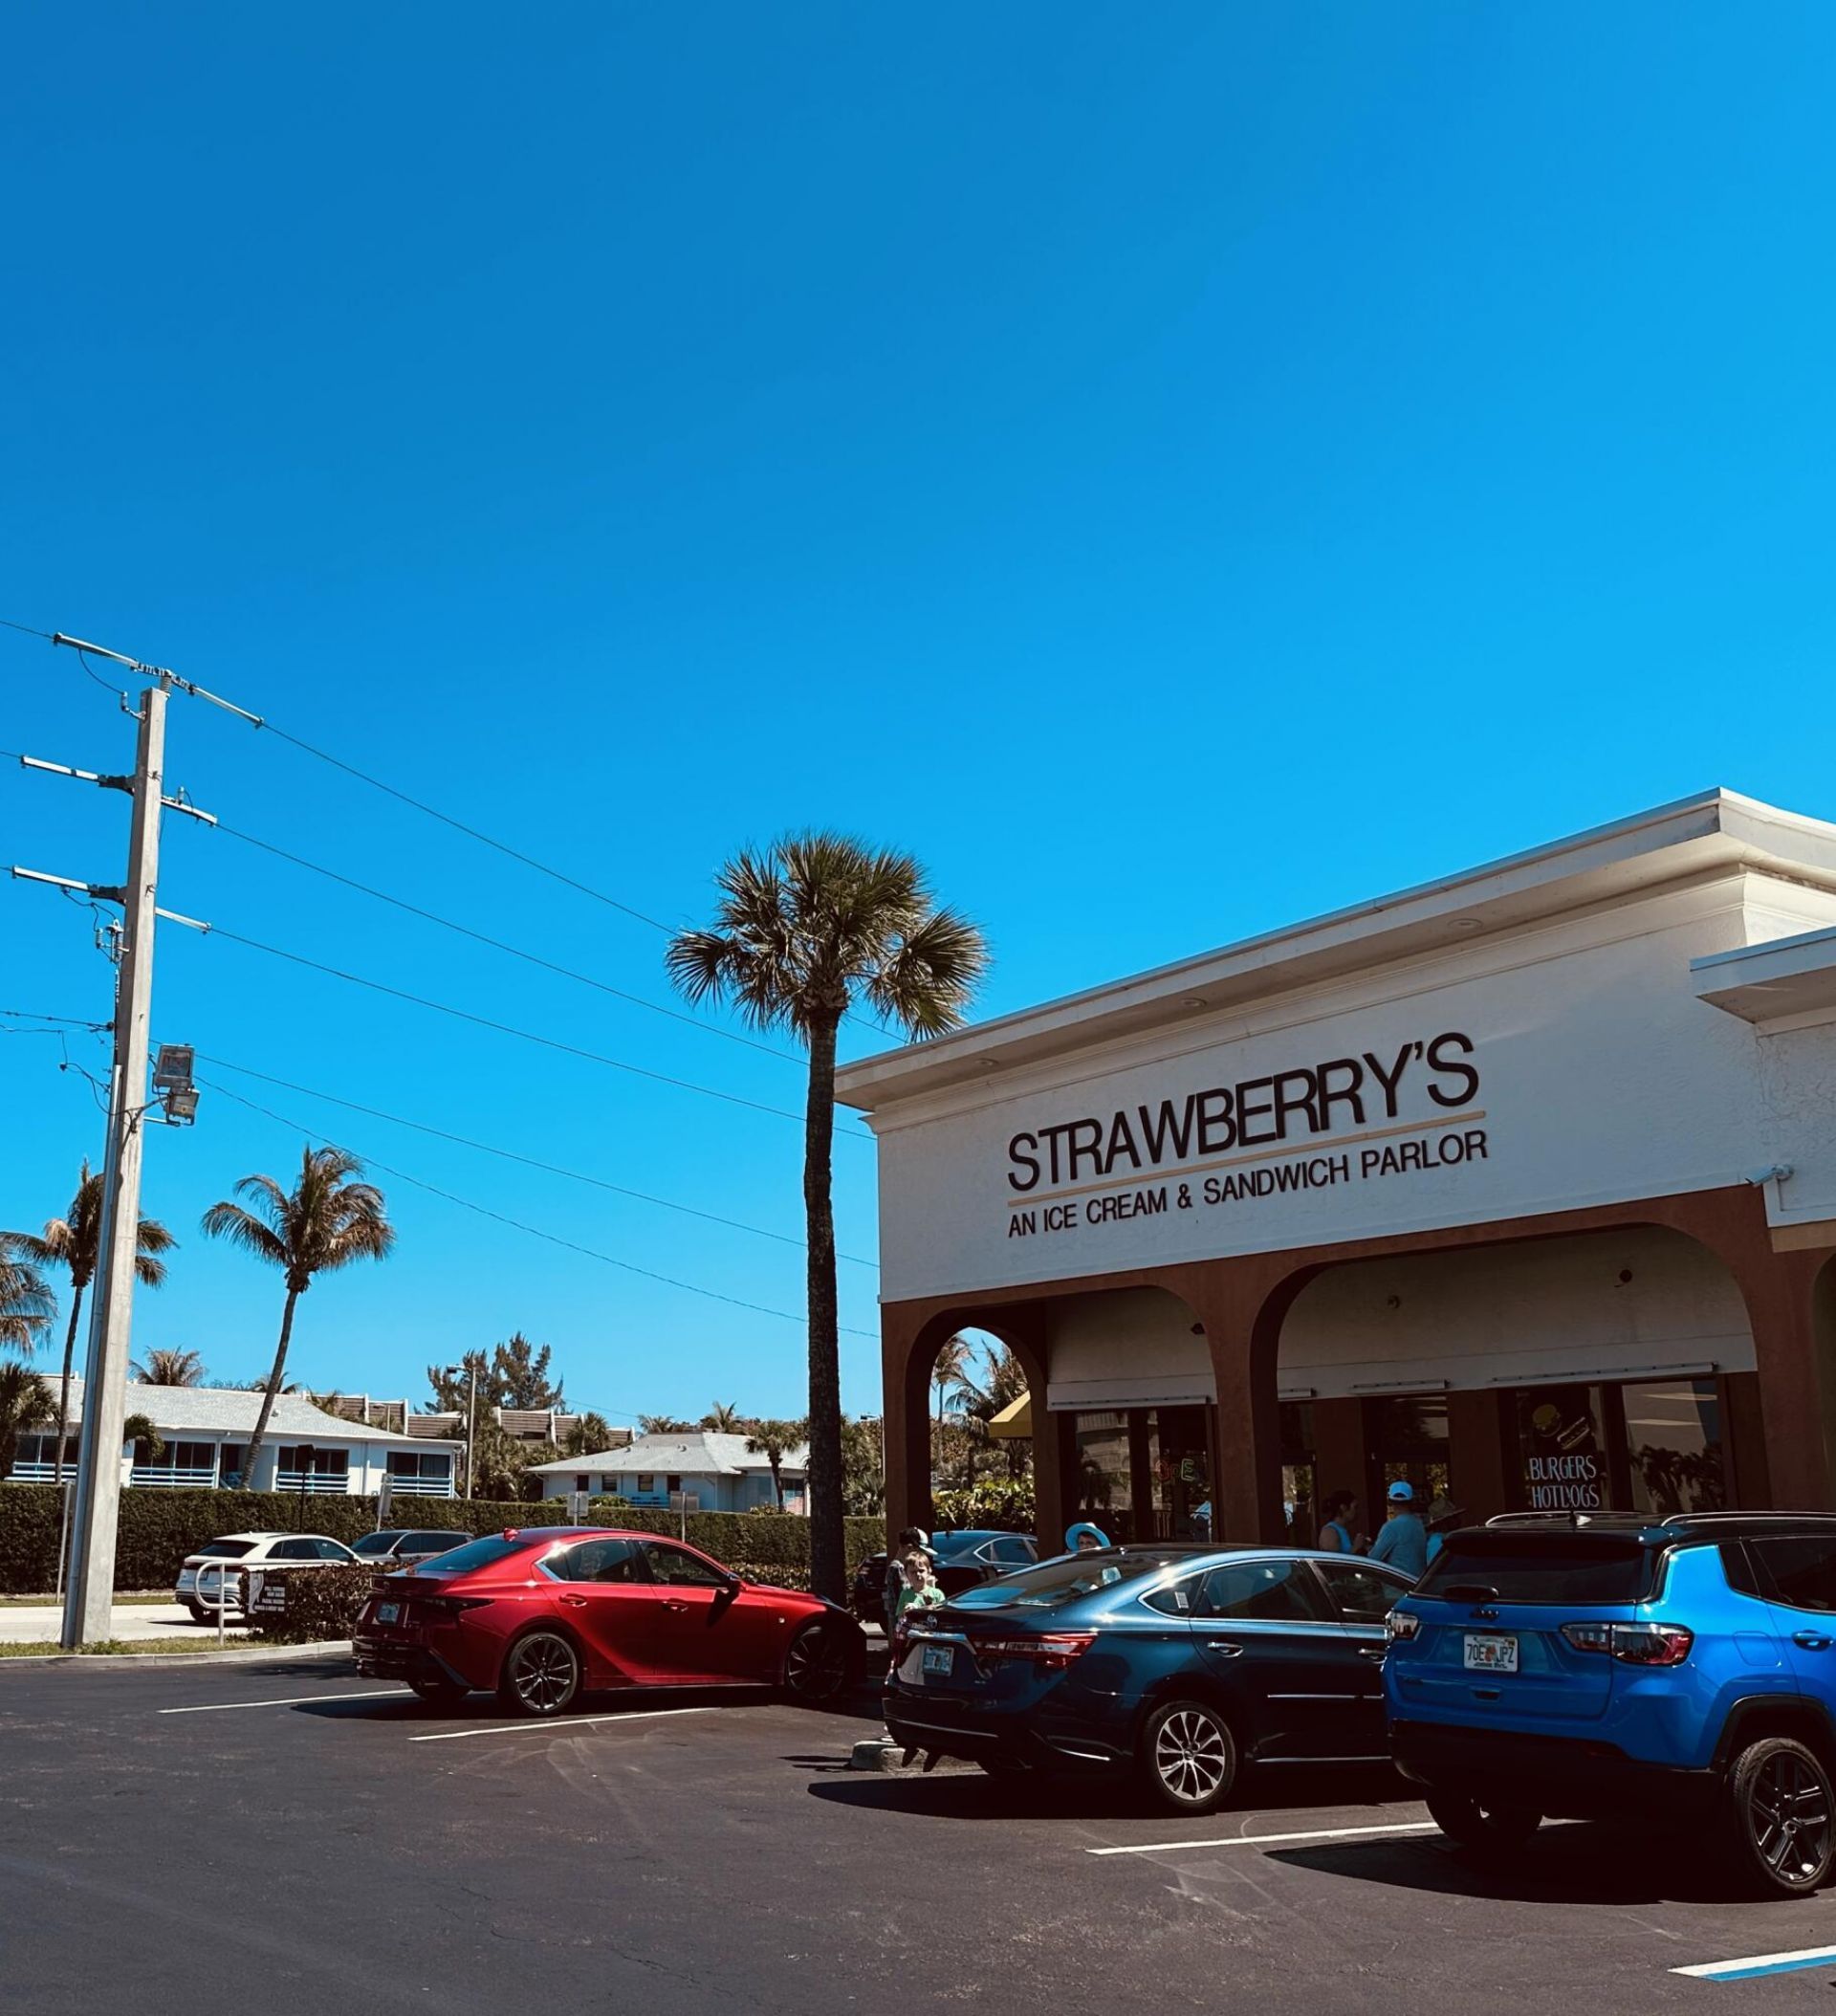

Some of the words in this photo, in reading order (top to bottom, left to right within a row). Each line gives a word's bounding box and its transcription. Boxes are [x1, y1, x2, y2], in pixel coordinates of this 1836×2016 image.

[1008, 1033, 1479, 1191] STRAWBERRY'S
[1008, 1211, 1036, 1238] AN
[1043, 1204, 1077, 1232] ICE
[1085, 1187, 1167, 1224] CREAM
[1177, 1184, 1192, 1209] &
[1203, 1154, 1349, 1204] SANDWICH
[1361, 1130, 1487, 1178] PARLOR
[1530, 1456, 1597, 1481] BURGERS
